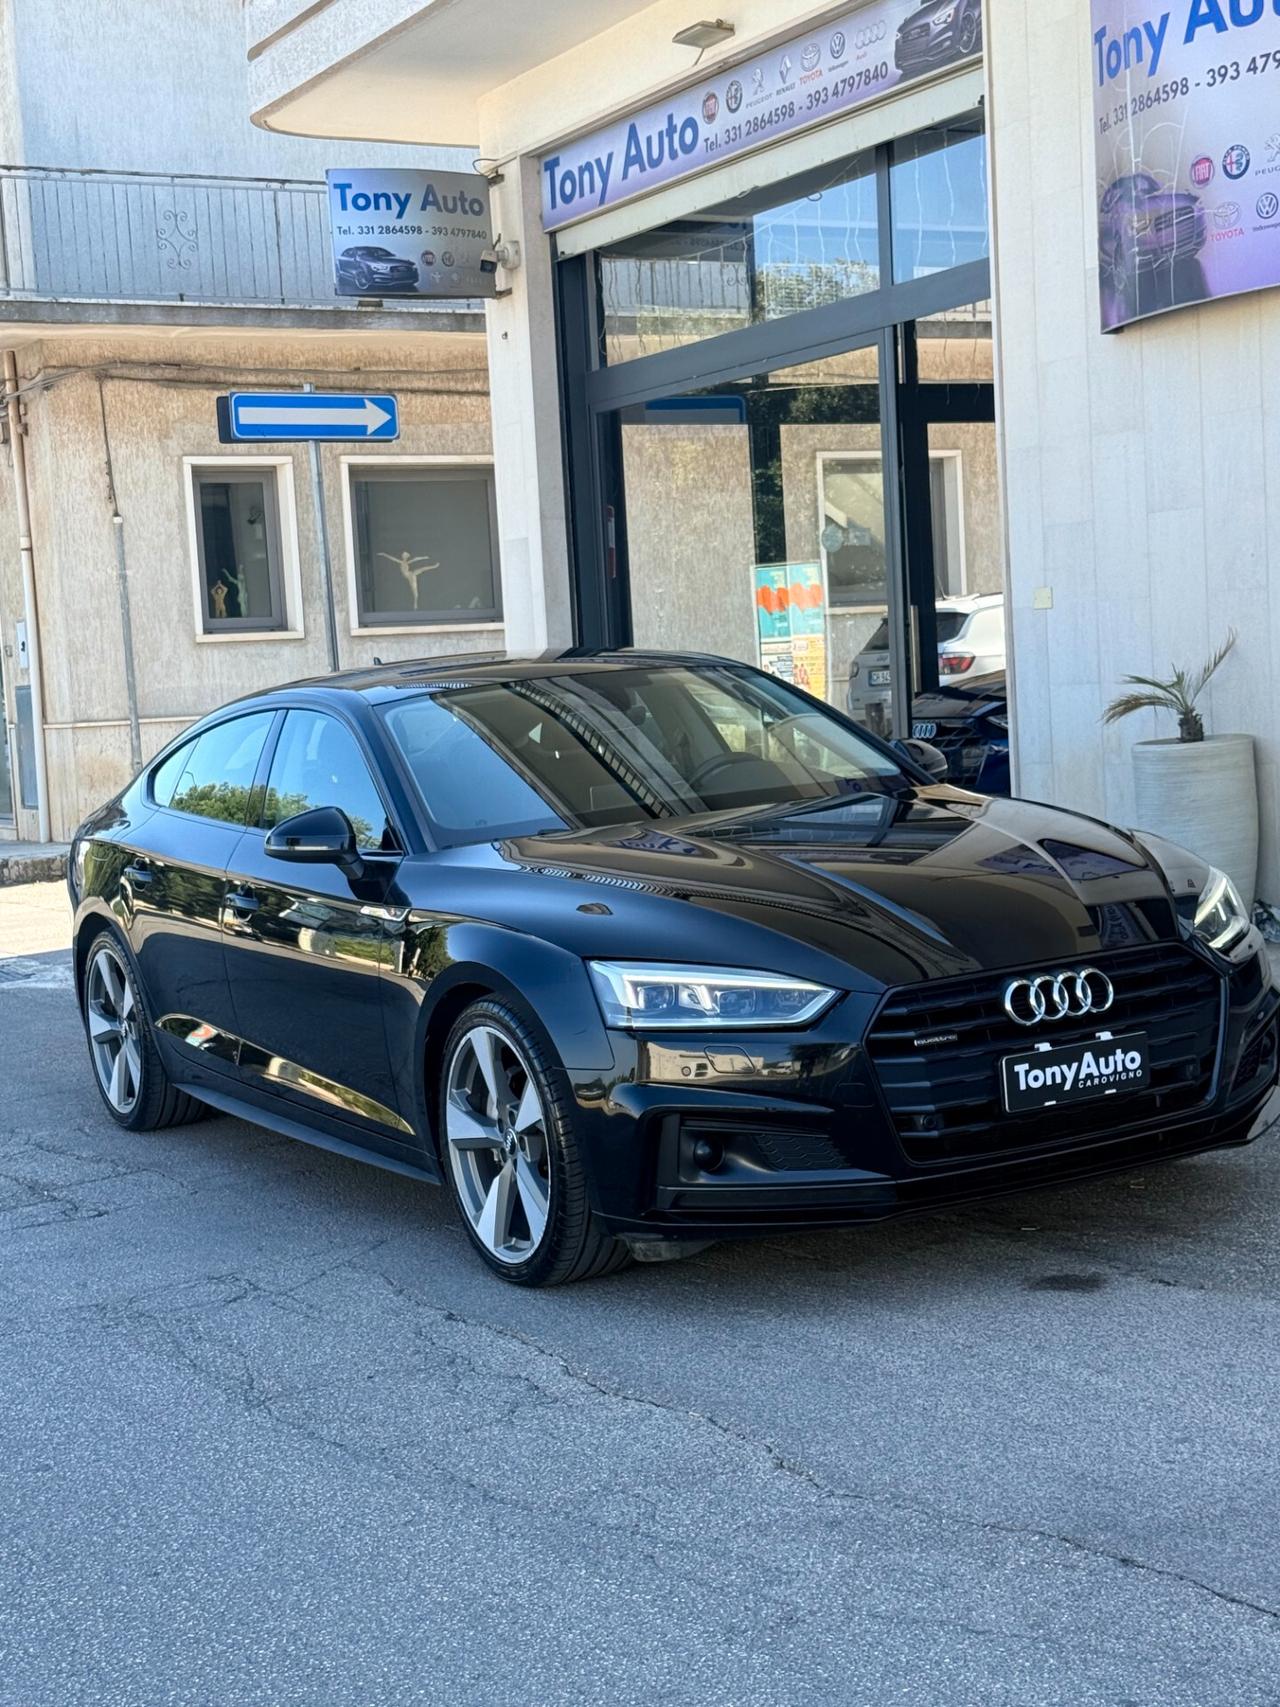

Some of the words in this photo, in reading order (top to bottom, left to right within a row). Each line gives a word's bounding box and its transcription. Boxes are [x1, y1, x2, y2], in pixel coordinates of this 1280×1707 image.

[1094, 12, 1170, 87] Tony
[1183, 0, 1280, 45] Au
[800, 69, 823, 85] TOYOTA
[704, 135, 721, 153] Tel.
[724, 124, 742, 145] 331
[745, 101, 795, 137] 2864598
[806, 87, 829, 111] 393
[832, 61, 888, 98] 4797840
[746, 94, 773, 109] PEUGEOT
[1099, 113, 1111, 135] Tel.
[1113, 102, 1128, 125] 331
[1131, 77, 1189, 117] 2864598
[1206, 61, 1240, 88] 393
[543, 151, 614, 207] Tony
[622, 113, 699, 182] Auto
[333, 183, 412, 219] Tony
[420, 184, 484, 217] Auto
[337, 226, 355, 235] Tel.
[358, 226, 375, 235] 331
[378, 226, 423, 235] 2864598
[431, 226, 448, 236] 393
[450, 227, 487, 239] 4797840
[1211, 228, 1244, 242] TOYOTA
[1078, 1069, 1142, 1089] CAROVIGNO
